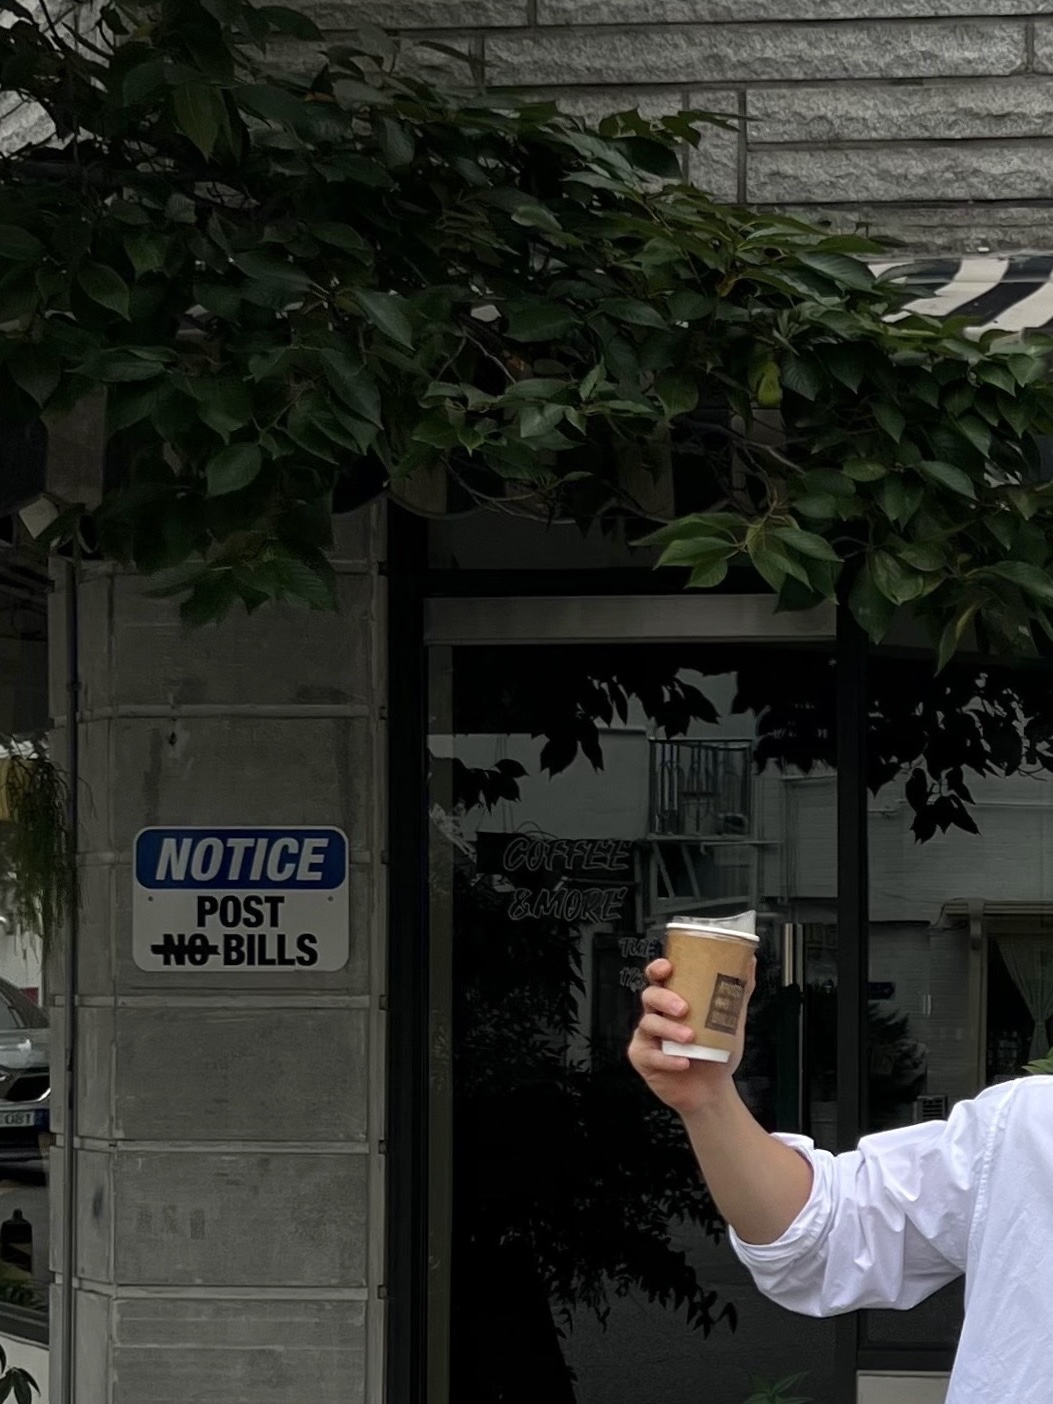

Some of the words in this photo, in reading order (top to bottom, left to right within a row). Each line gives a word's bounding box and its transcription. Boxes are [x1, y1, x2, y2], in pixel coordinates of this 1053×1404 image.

[155, 837, 329, 882] NOTICE
[503, 837, 633, 872] COFFEE
[196, 895, 285, 928] POST
[162, 933, 211, 966] NO
[222, 933, 319, 967] BILLS
